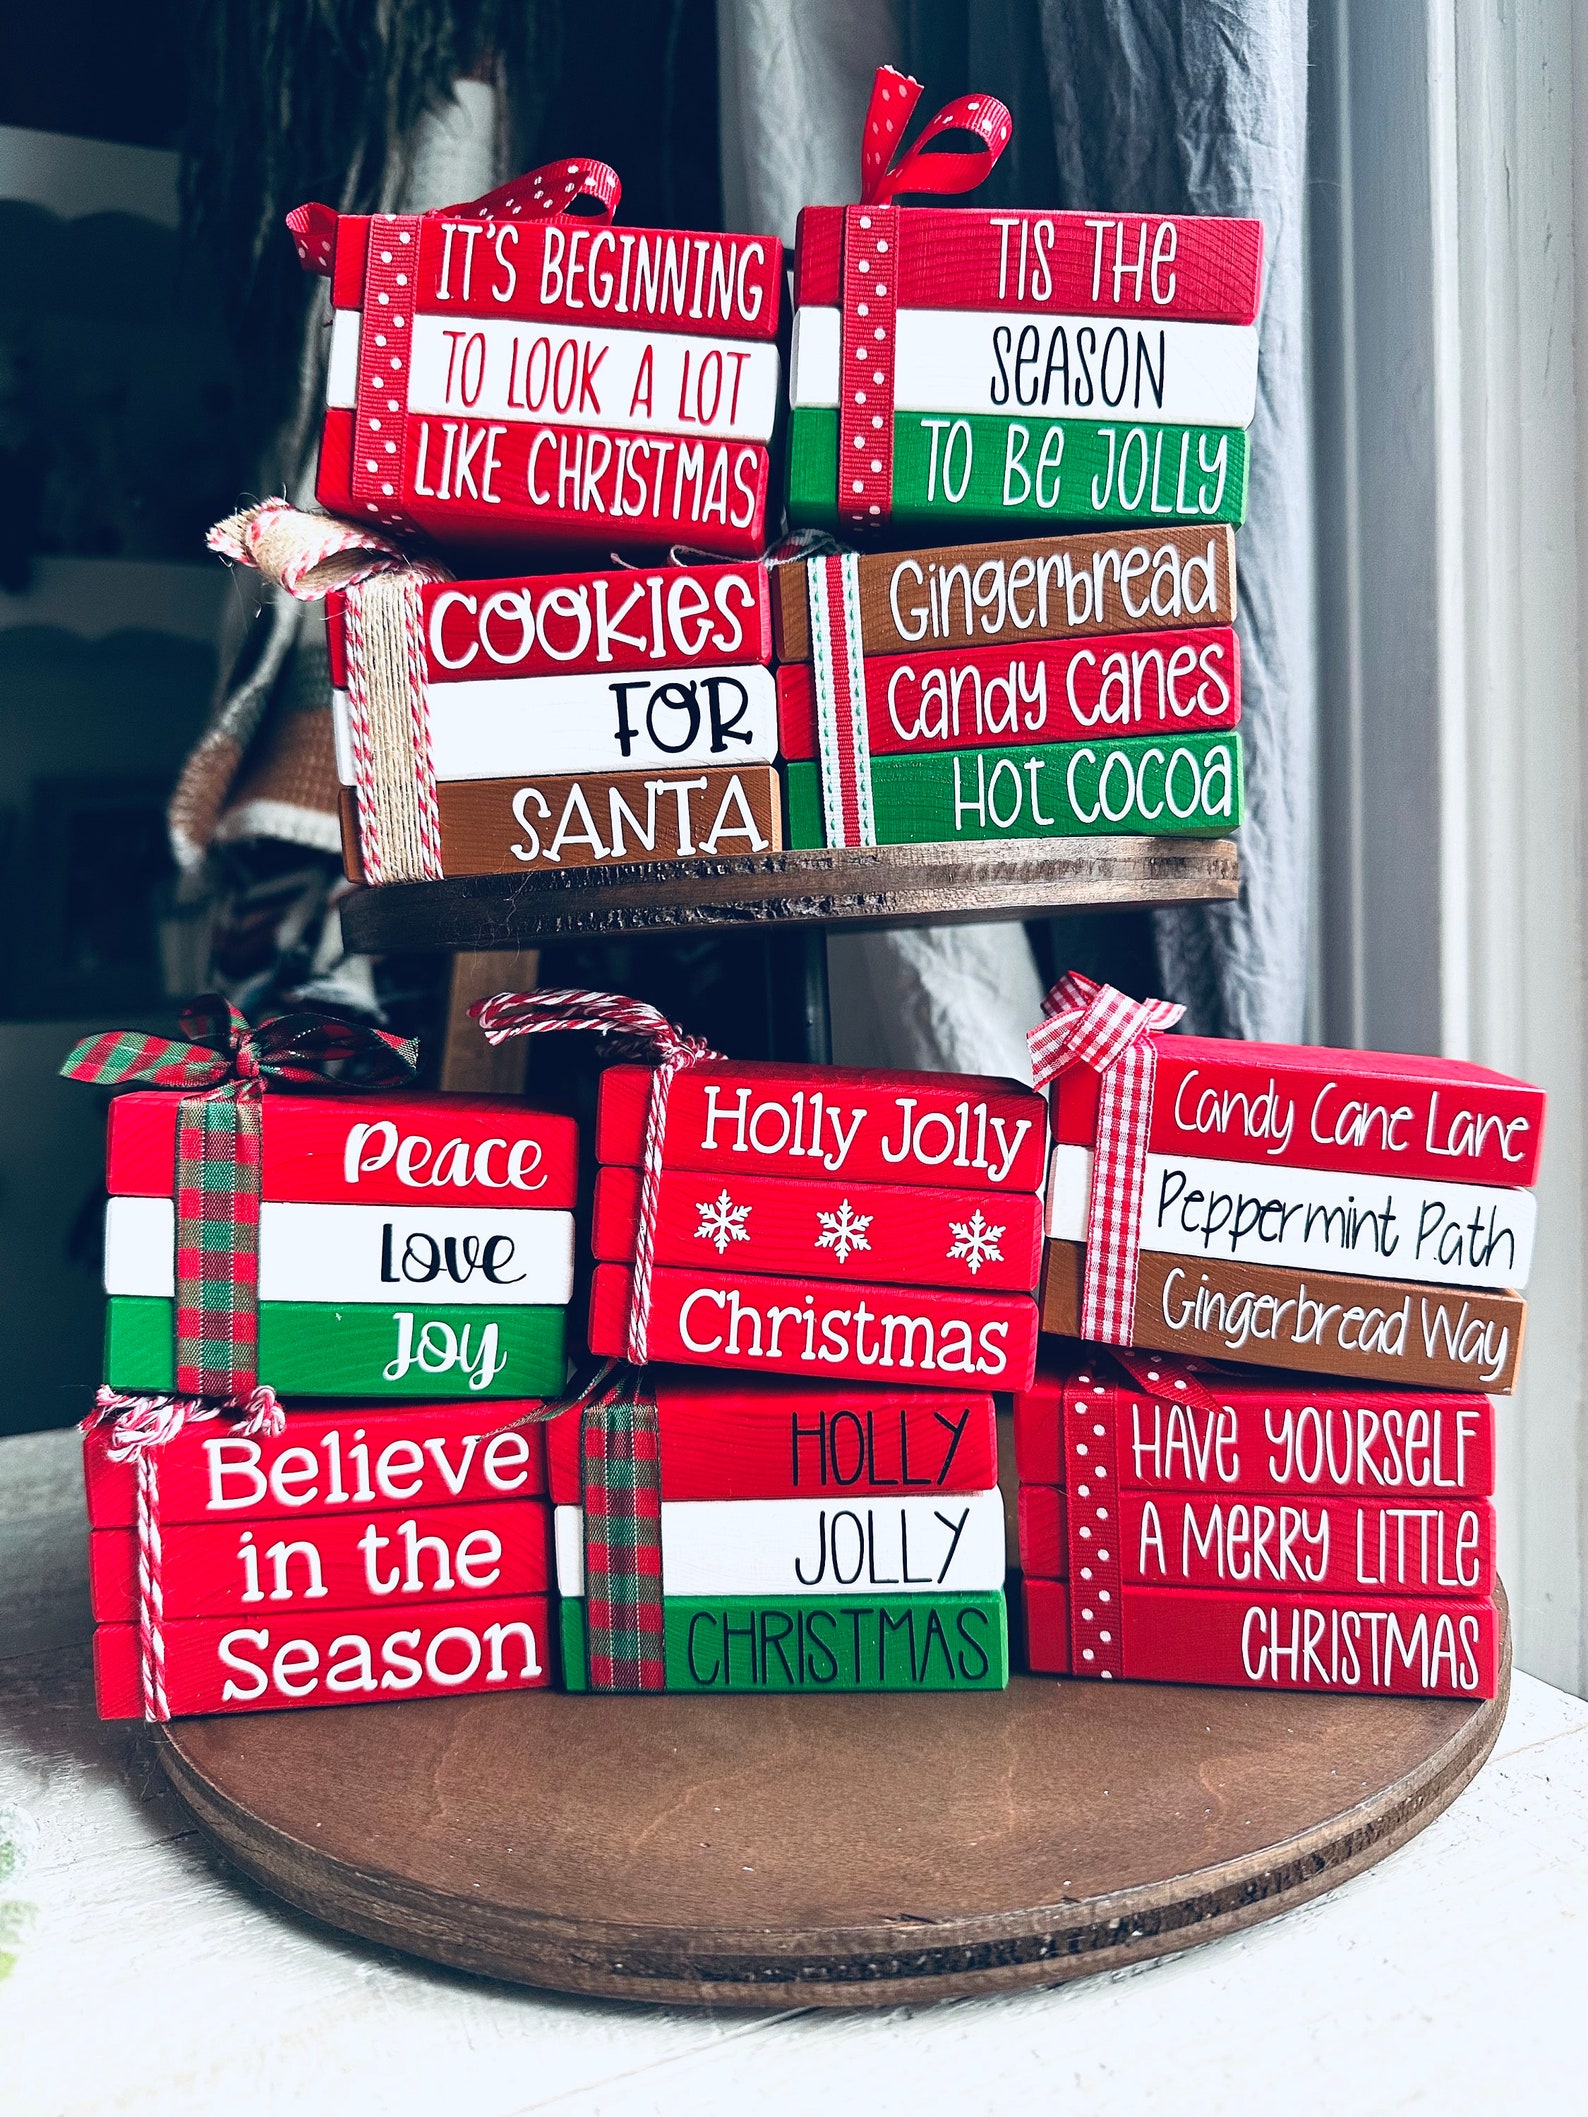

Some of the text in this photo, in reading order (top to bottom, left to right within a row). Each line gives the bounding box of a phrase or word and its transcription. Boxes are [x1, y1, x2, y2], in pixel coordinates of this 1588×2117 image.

[436, 223, 765, 322] IT'S BEGINNING
[989, 218, 1055, 302] TIS
[442, 330, 752, 426] TO LOOK A LOT
[415, 421, 758, 528] LIKE CHRISTMAS
[921, 419, 973, 503] TO
[889, 539, 1217, 642] Gingerbread
[608, 676, 753, 757] FOR
[887, 643, 1229, 741] Candy Canes
[510, 774, 769, 862] SANTA
[344, 1120, 548, 1191] Peace
[700, 1085, 1032, 1182] Holly Jolly
[1174, 1069, 1530, 1163] Candy Cane Lane
[381, 1223, 527, 1283] Love
[1157, 1169, 1514, 1270] Peppermint Path
[383, 1312, 507, 1390] Joy
[678, 1288, 1009, 1375] Christmas
[1162, 1267, 1509, 1381] Gingerbread Way
[201, 1429, 530, 1510] Believe
[792, 1408, 969, 1486] HOLLY
[236, 1519, 502, 1602] in the
[795, 1508, 970, 1585] JOLLY
[1139, 1501, 1165, 1575] A
[217, 1621, 542, 1701] Season
[688, 1607, 989, 1685] CHRISTMAS
[1241, 1606, 1479, 1691] CHRISTMAS
